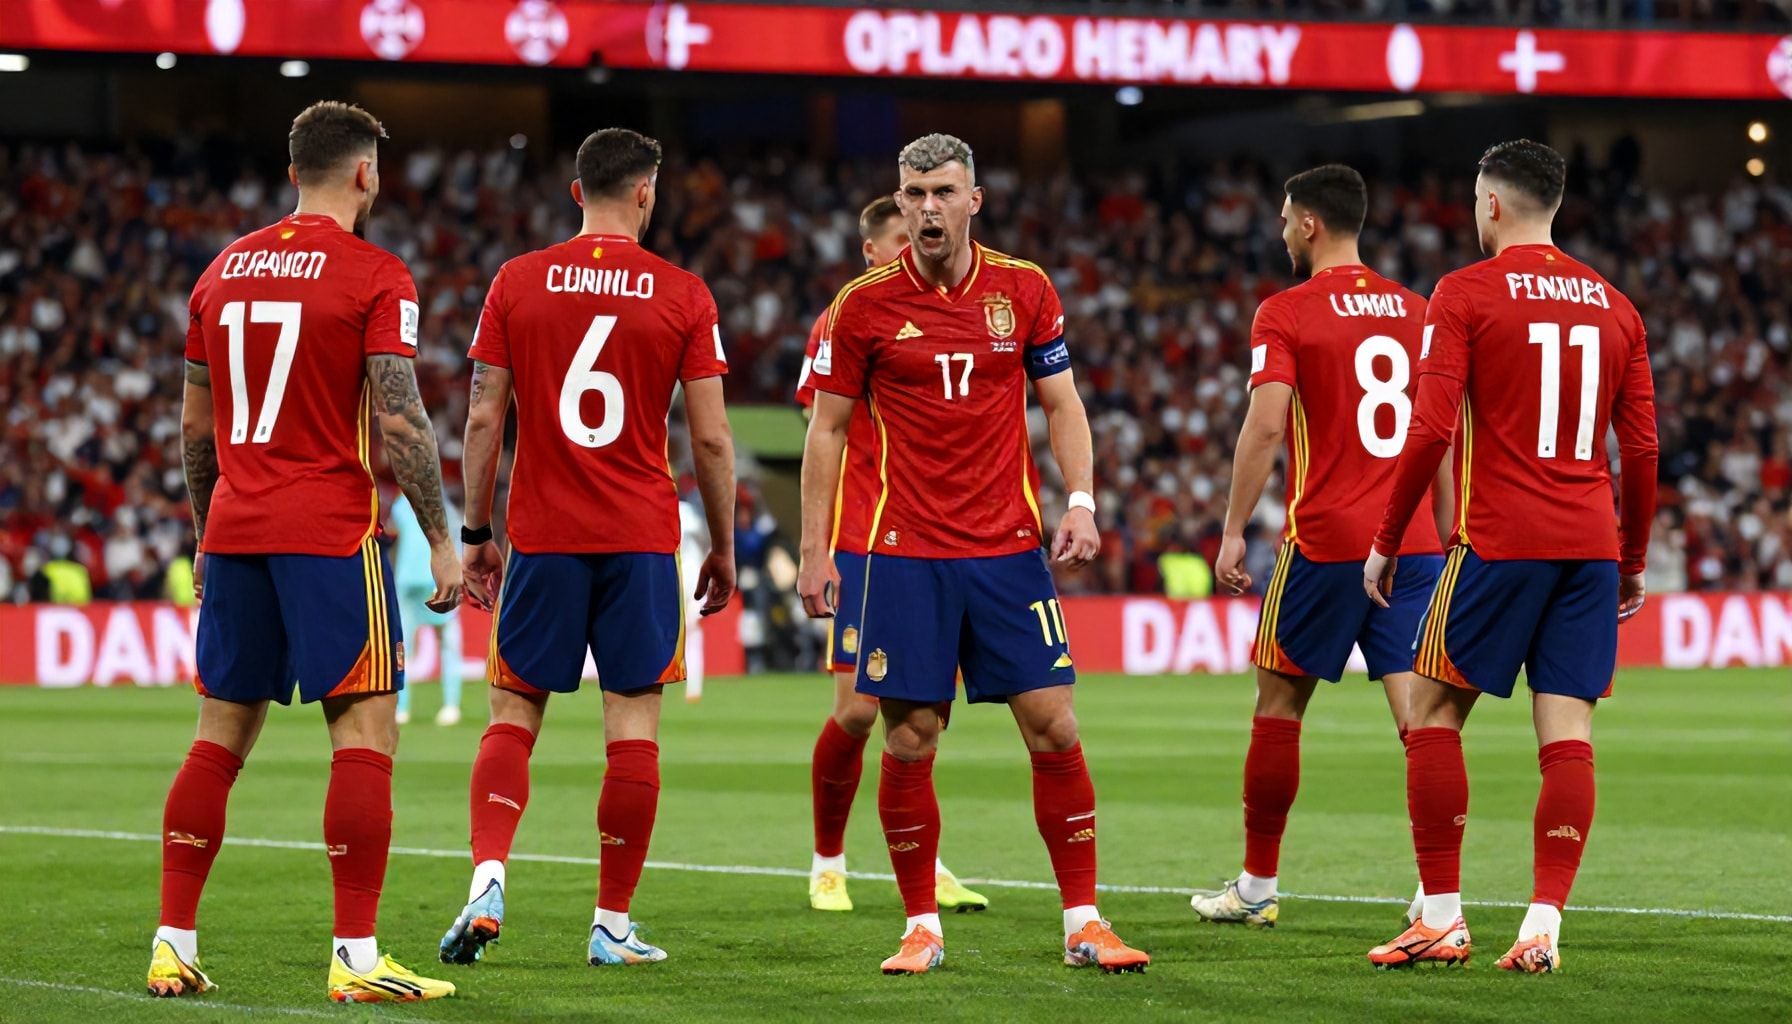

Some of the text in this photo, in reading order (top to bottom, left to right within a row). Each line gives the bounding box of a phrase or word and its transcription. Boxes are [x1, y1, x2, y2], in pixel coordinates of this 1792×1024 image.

[220, 302, 301, 444] 17
[559, 315, 625, 447] 6
[935, 353, 974, 399] 17
[1355, 336, 1412, 457] 8
[1529, 323, 1600, 460] 11
